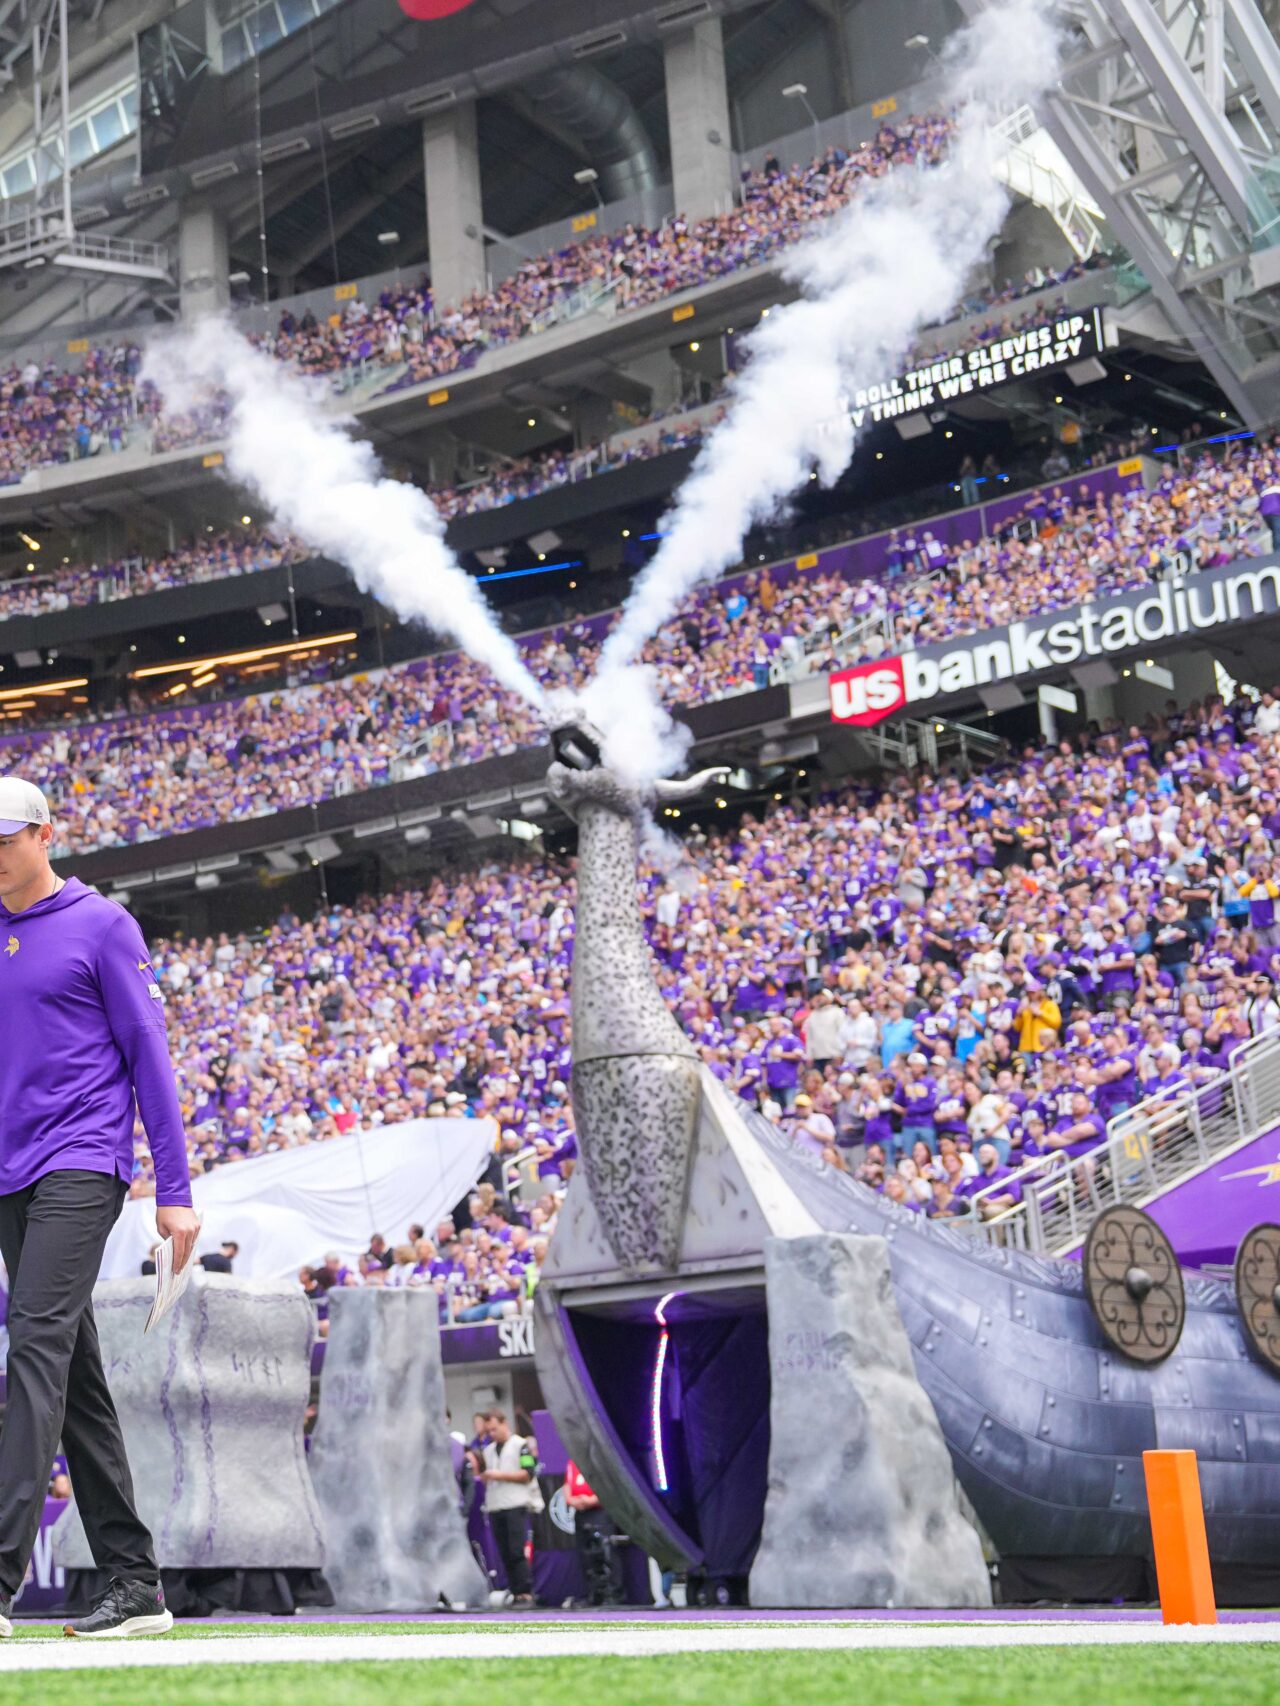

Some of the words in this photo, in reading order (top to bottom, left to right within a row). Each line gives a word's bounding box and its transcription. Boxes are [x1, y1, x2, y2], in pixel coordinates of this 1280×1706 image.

[855, 380, 903, 407] ROLL
[905, 357, 964, 391] THEIR
[968, 327, 1051, 370] SLEEVES
[1056, 316, 1091, 340] UP.
[870, 388, 935, 422] THINK
[938, 363, 1007, 399] WE'RE
[1011, 336, 1082, 375] CRAZY
